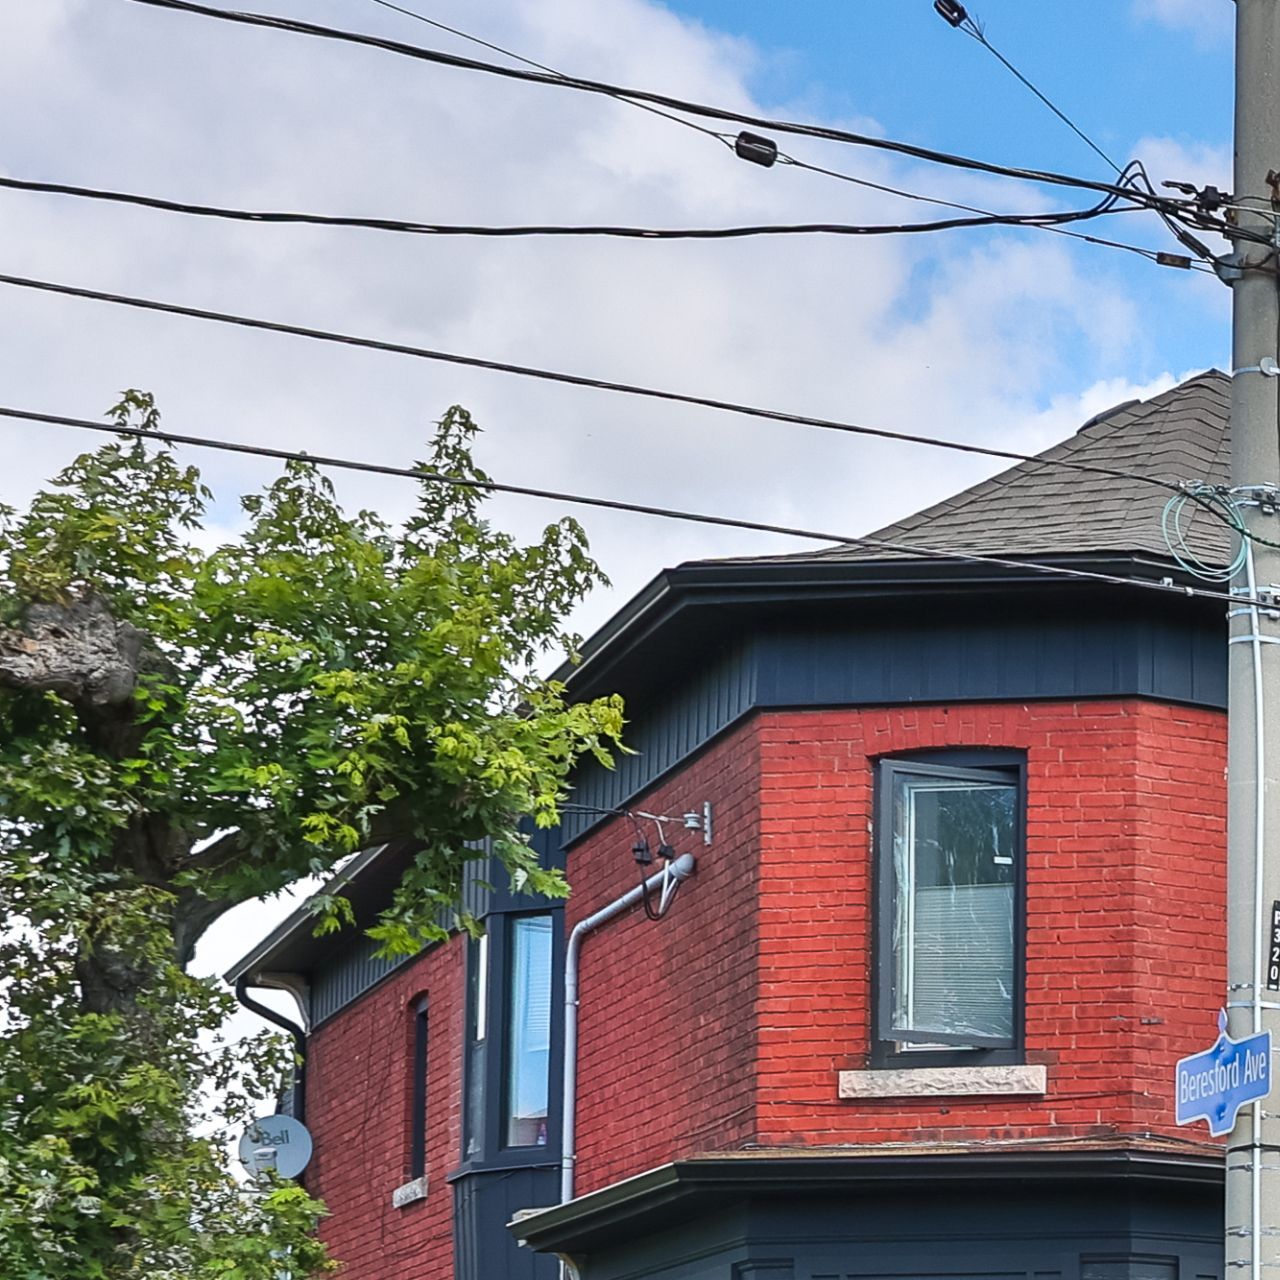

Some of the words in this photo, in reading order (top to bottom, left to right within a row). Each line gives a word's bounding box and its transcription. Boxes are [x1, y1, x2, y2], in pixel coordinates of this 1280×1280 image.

[1180, 1052, 1240, 1104] Beresford
[1243, 1049, 1267, 1085] Ave
[262, 1130, 290, 1146] Bell
